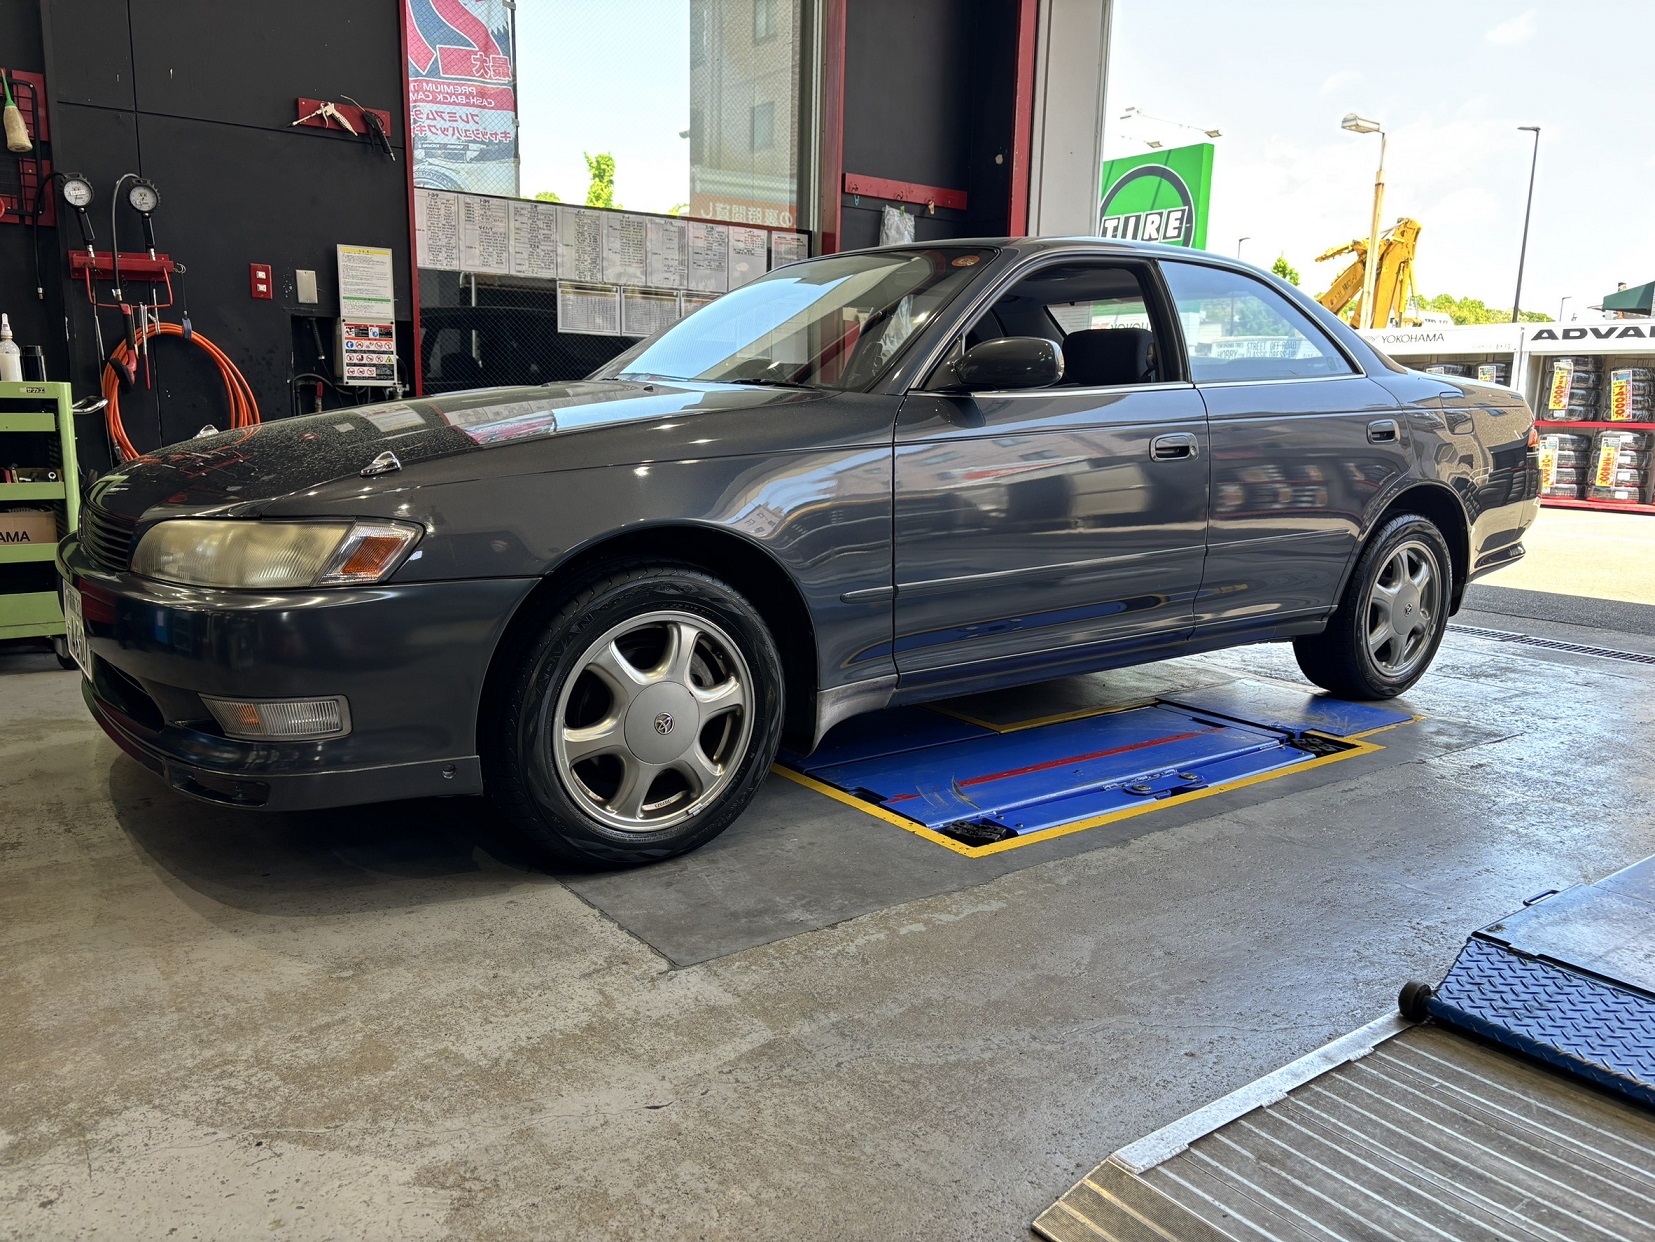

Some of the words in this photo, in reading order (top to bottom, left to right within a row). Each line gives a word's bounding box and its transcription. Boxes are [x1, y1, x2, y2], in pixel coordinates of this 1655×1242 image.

[1104, 210, 1182, 240] TIRE
[1381, 333, 1445, 344] YOKOHAMA
[1530, 326, 1655, 341] ADVA
